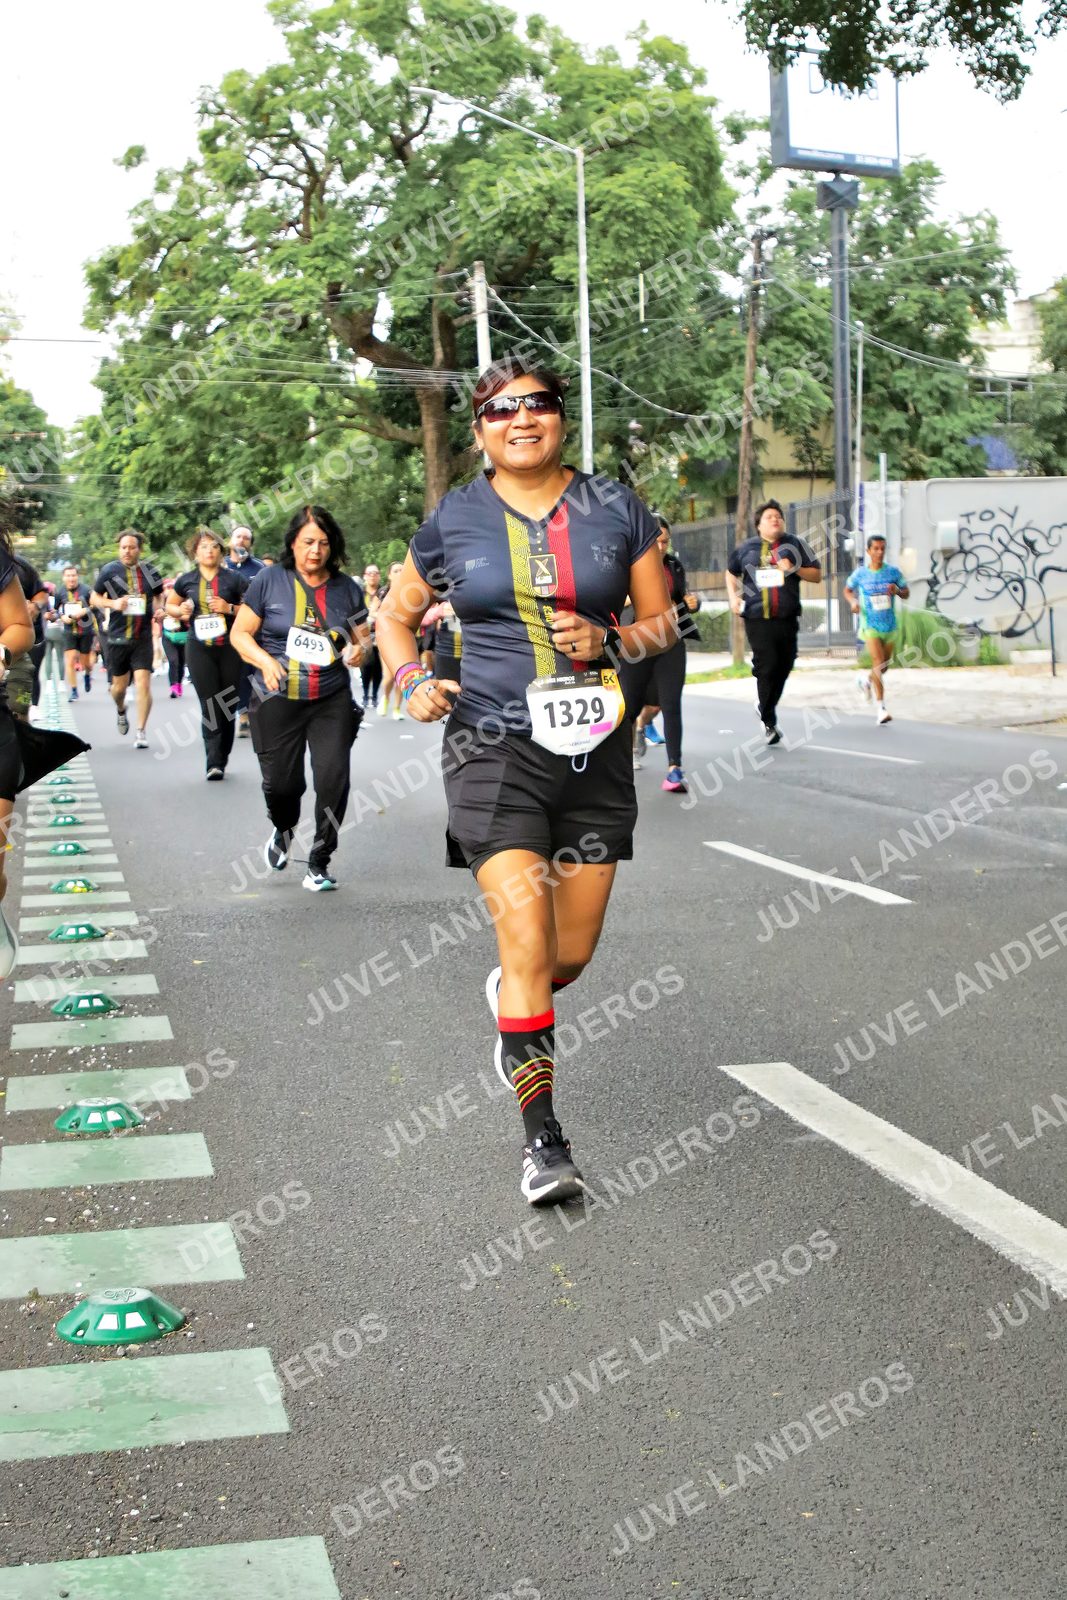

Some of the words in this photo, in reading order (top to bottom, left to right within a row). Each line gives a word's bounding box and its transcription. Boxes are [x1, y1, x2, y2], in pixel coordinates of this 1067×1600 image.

[960, 505, 1018, 528] TOY
[294, 635, 325, 652] 6493
[543, 697, 605, 728] 1329
